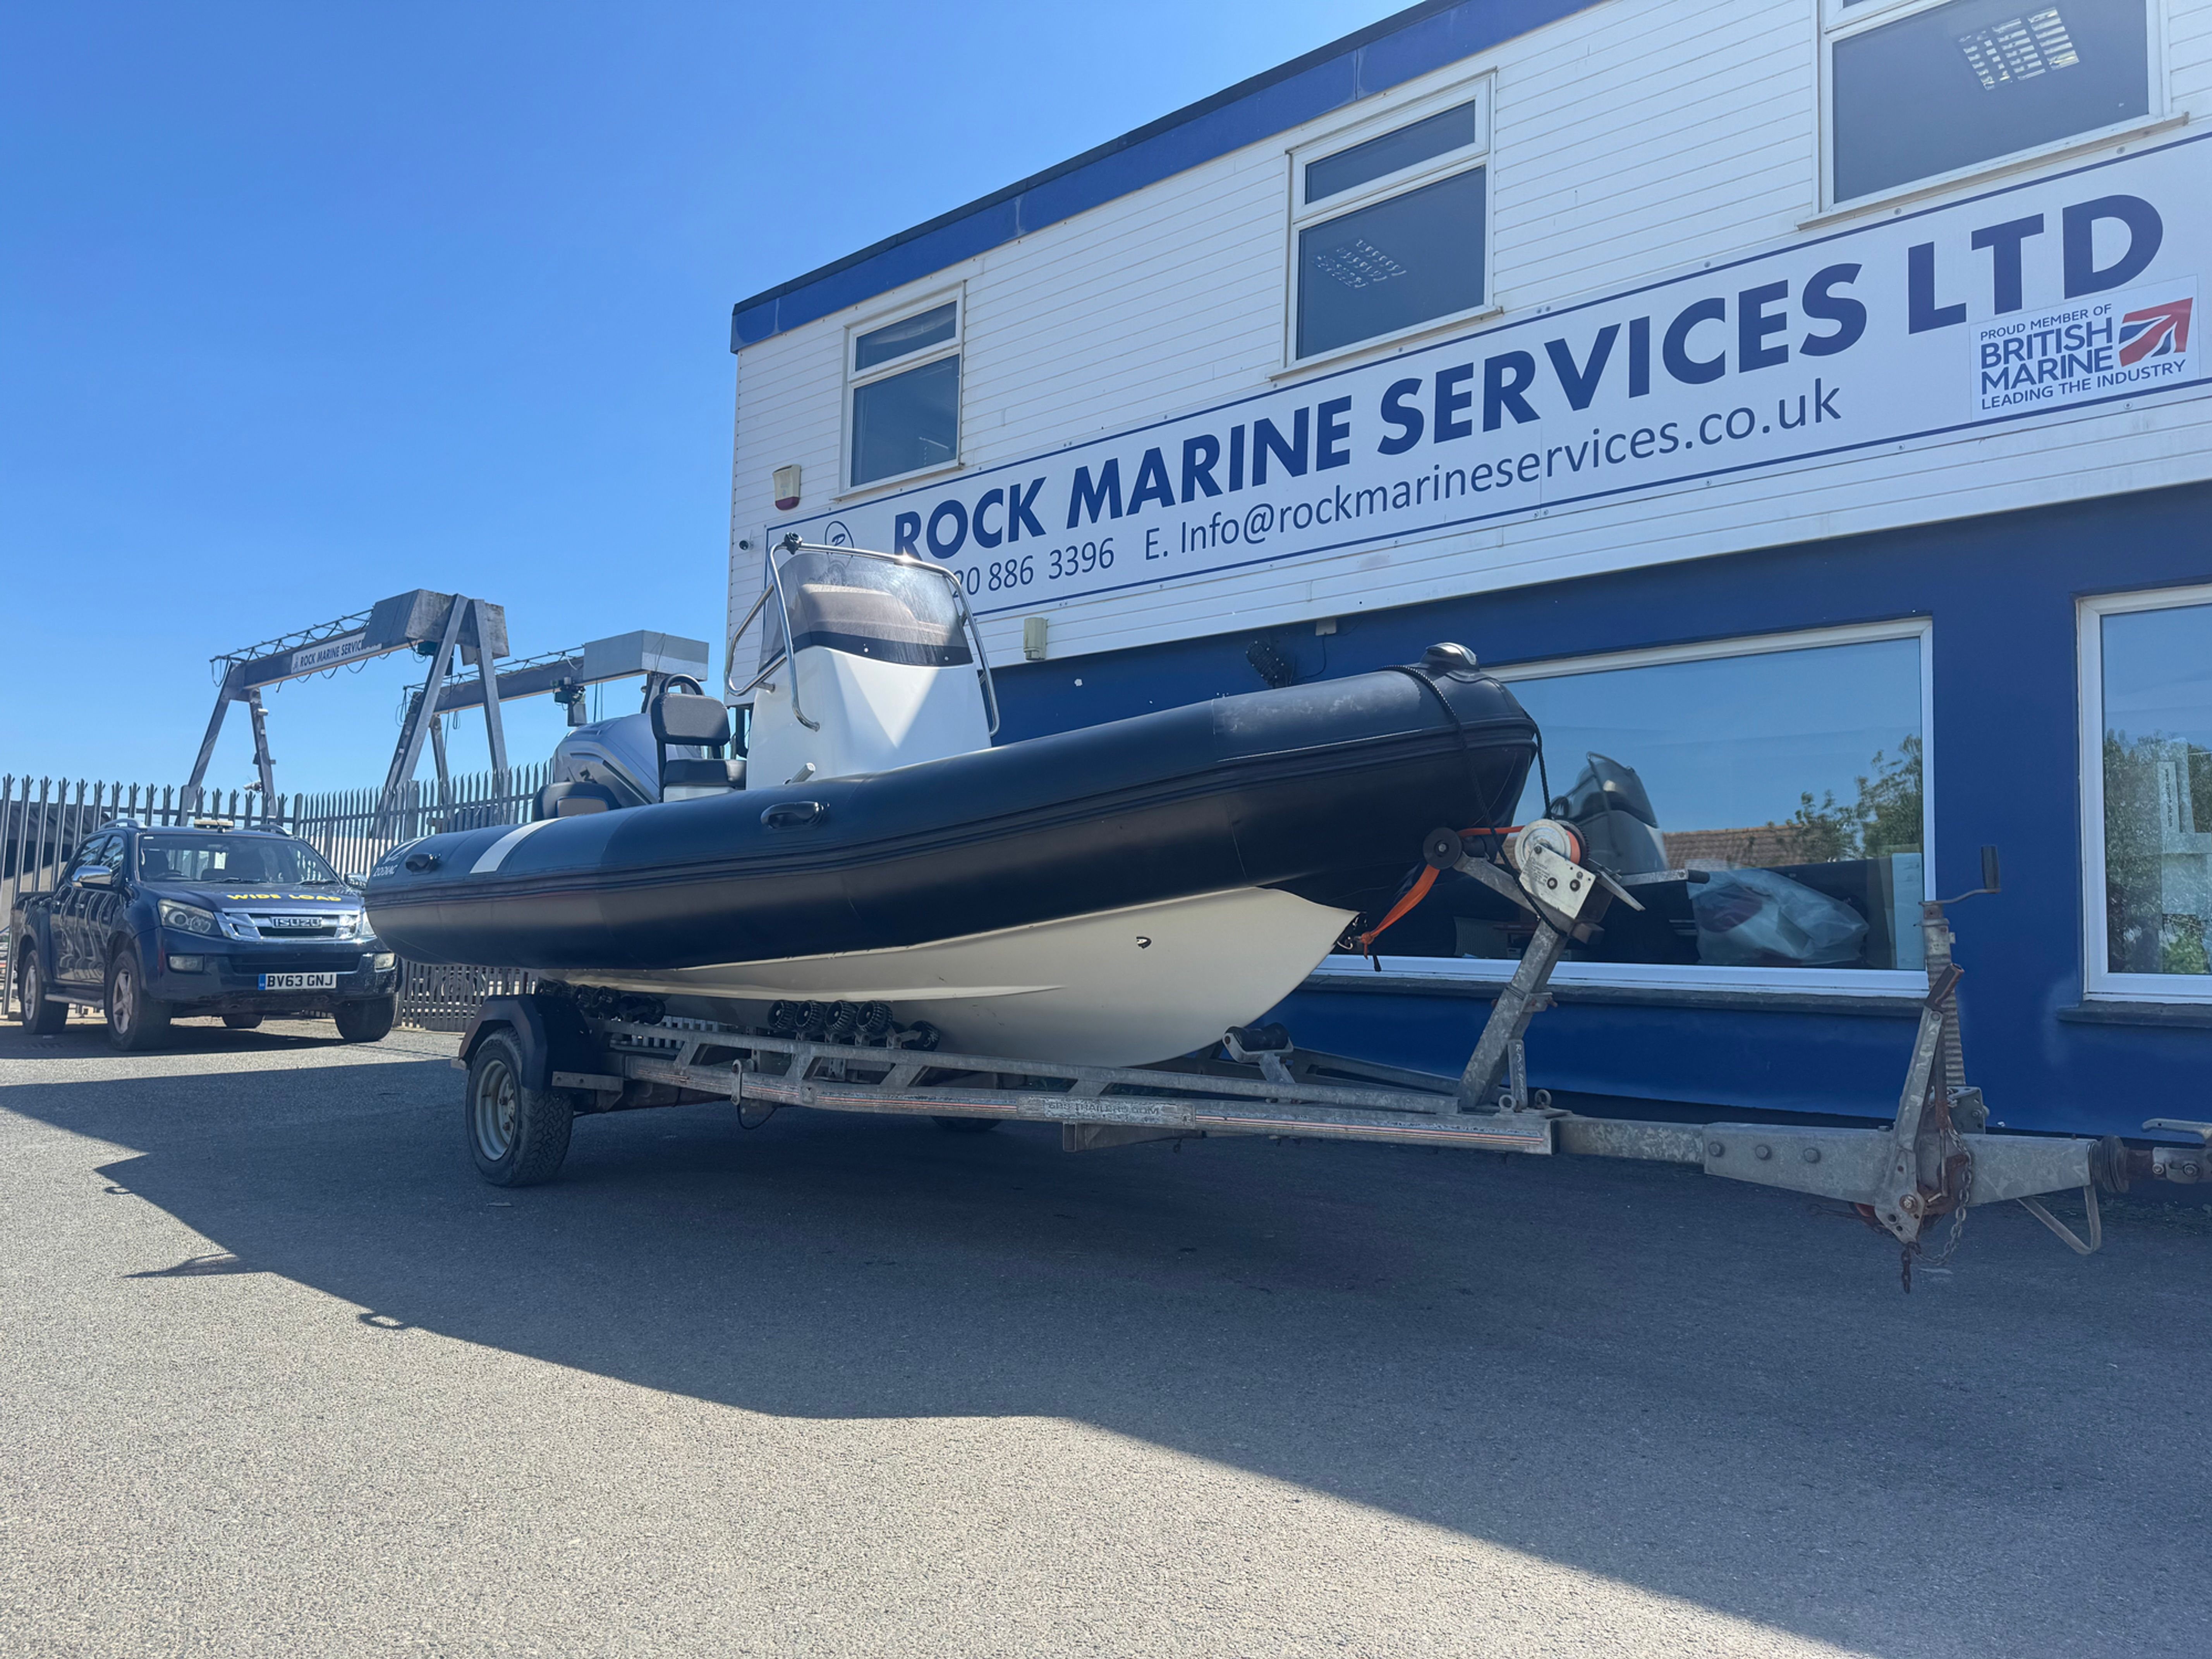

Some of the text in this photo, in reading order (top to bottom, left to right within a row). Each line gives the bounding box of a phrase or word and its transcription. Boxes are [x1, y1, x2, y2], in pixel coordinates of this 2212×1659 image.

[1980, 304, 2112, 341] PROUD MEMBER OF
[1981, 318, 2112, 369] BRITISH
[894, 194, 2163, 565] ROCK MARINE SERVICES LTD
[1982, 345, 2113, 395] MARINE
[1982, 359, 2186, 410] LEADING THE INDUSTRY
[988, 555, 1034, 591] 886
[1049, 538, 1114, 579] 3396
[1146, 527, 1168, 560] E.
[1182, 378, 1841, 553] Info@rockmarineservices.co.uk
[300, 653, 316, 667] ROCK
[317, 645, 340, 661] MARINE
[274, 918, 320, 927] ISUZU
[267, 974, 333, 987] BV63 GNJ
